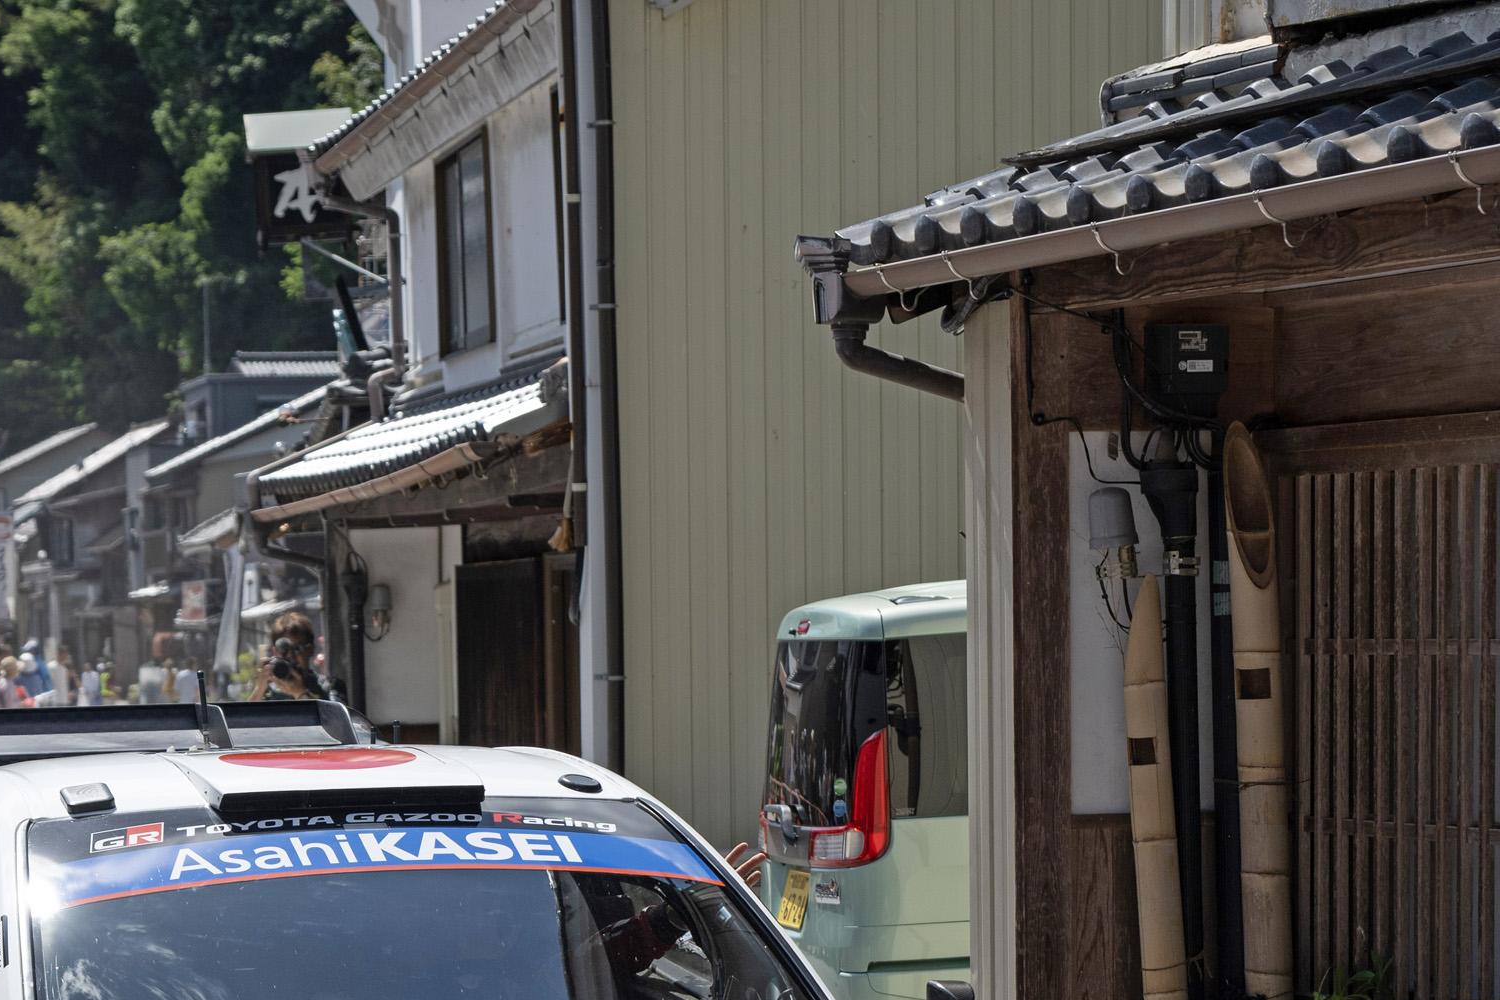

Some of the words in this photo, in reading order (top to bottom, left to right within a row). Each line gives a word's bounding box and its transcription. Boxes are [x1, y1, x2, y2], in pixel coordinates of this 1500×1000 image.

[93, 830, 160, 850] GR
[176, 815, 335, 837] TOYOTA
[345, 812, 483, 823] GAZOO
[493, 813, 618, 833] Racing
